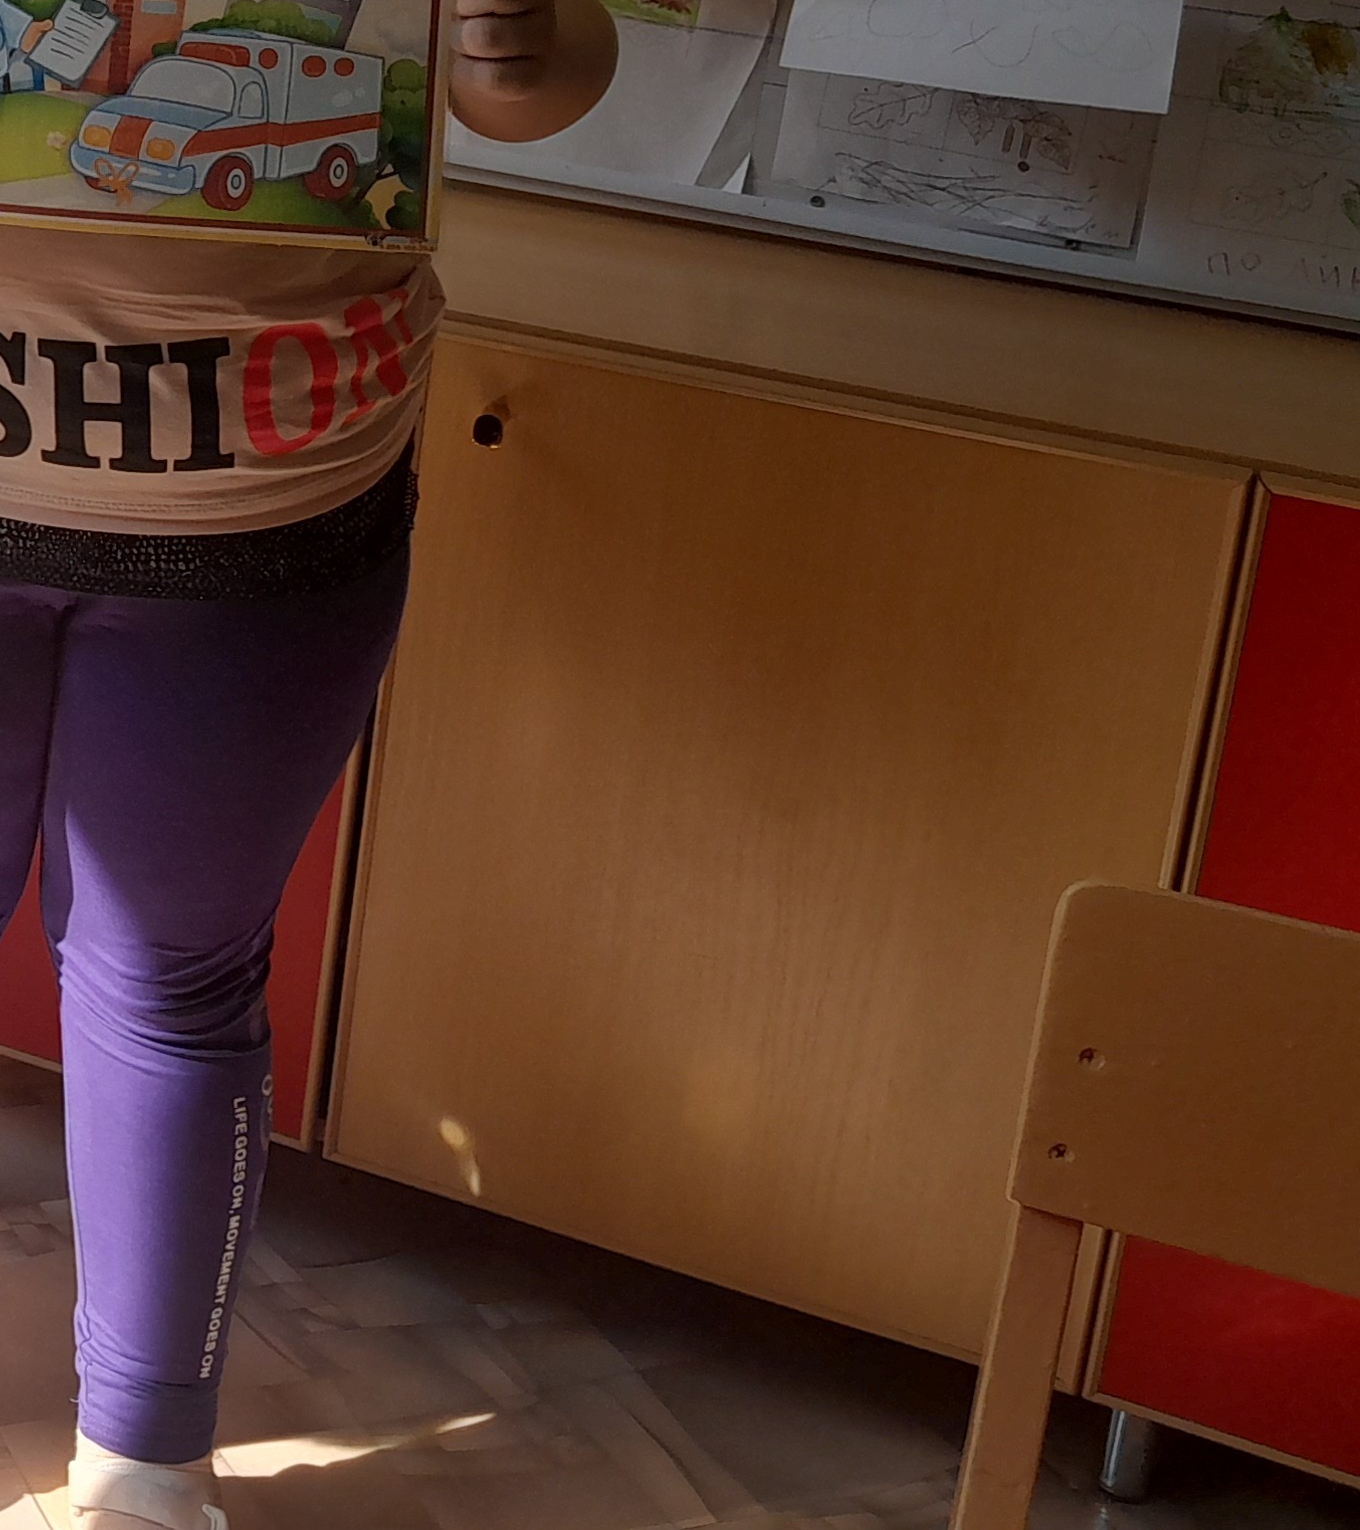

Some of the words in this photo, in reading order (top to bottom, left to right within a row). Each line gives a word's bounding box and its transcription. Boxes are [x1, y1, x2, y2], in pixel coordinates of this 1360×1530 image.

[231, 1135, 248, 1183] GOES
[216, 1214, 241, 1305] MOVEMENT
[203, 1306, 224, 1352] GOES
[199, 1354, 215, 1379] ON
